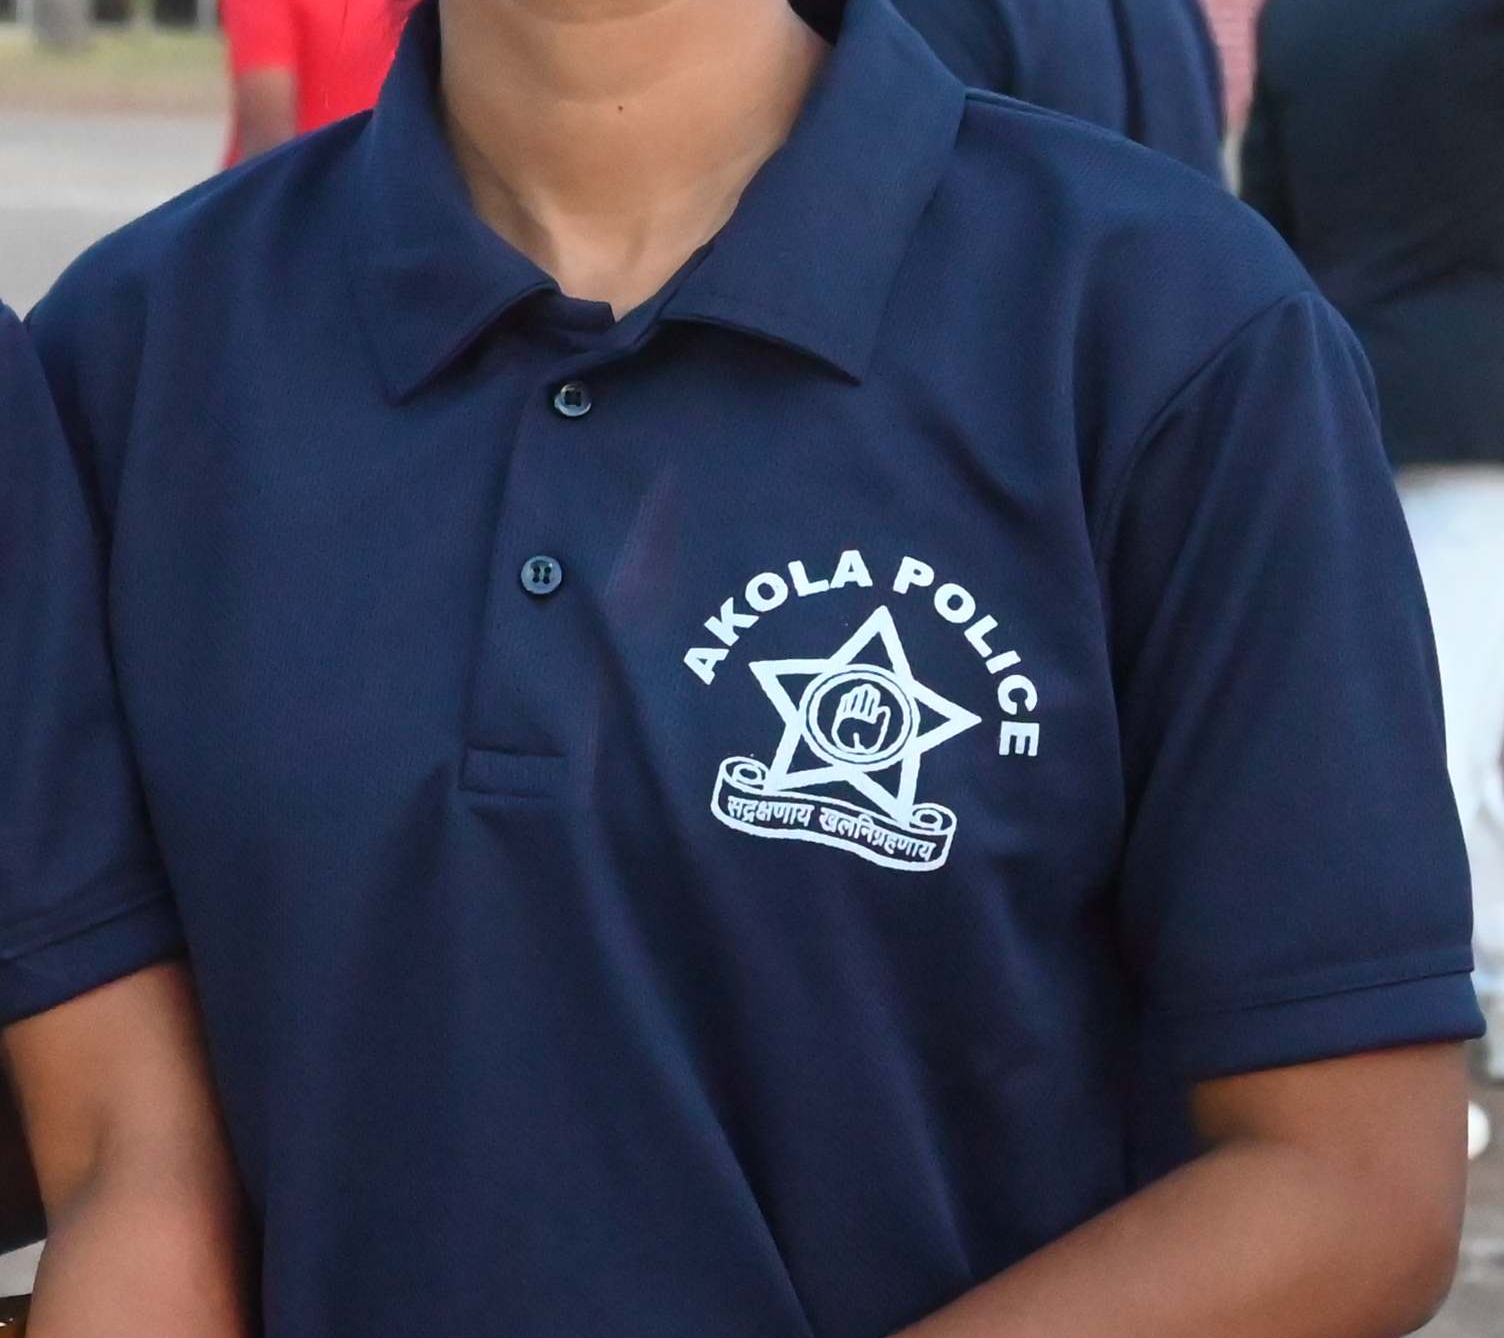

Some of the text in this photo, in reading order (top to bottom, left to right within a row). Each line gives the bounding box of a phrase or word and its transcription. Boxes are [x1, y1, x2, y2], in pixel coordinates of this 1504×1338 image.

[683, 549, 1040, 757] AKOLA POLICE
[727, 795, 937, 861] सद्रक्षणाय खलनिग्रहणाय
